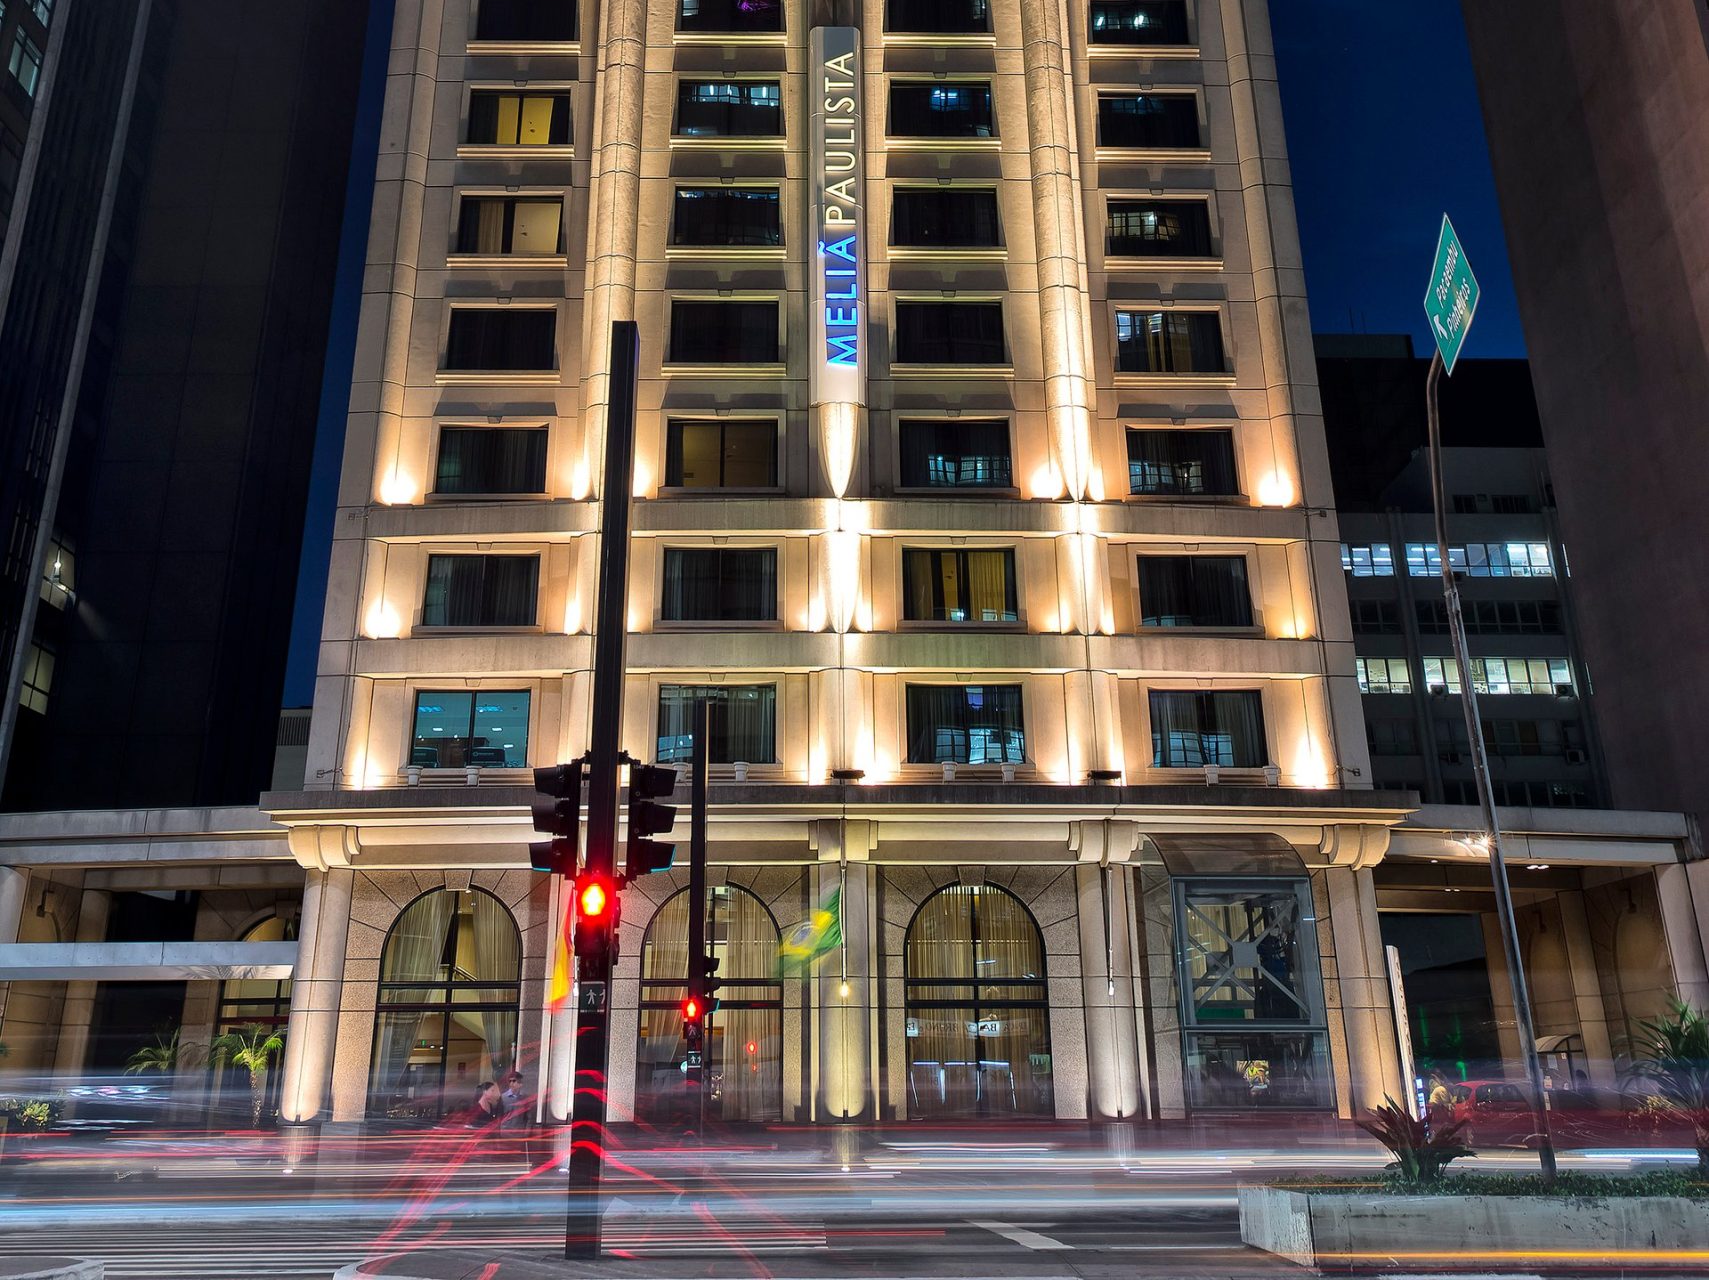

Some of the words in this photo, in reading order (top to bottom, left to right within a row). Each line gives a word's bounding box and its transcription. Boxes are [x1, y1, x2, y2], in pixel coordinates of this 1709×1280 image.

[825, 52, 856, 225] PAULISTA
[1436, 241, 1458, 308] Pacaembu
[1446, 278, 1471, 339] Pinheiros
